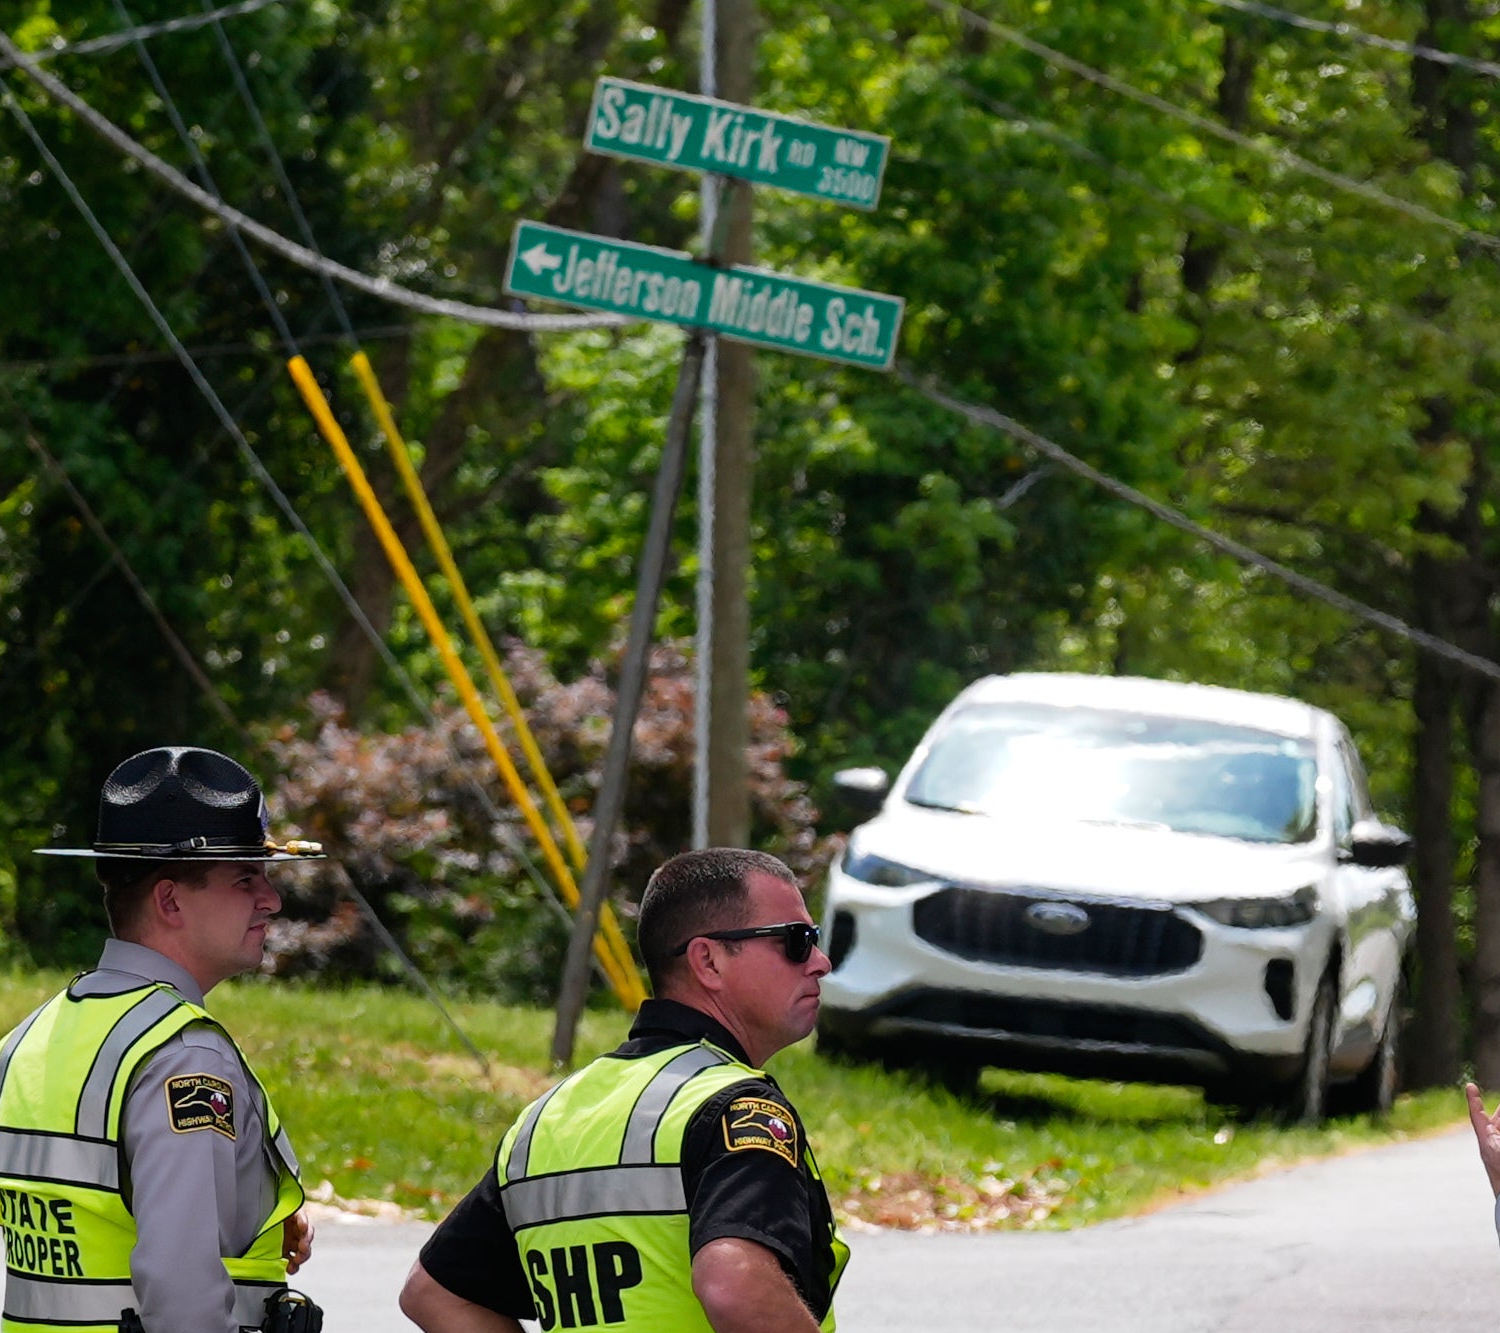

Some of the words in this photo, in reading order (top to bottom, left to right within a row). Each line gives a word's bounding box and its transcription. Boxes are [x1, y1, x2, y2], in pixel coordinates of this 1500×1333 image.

[596, 87, 693, 161] Sally
[701, 106, 782, 174] Kirk
[834, 137, 870, 168] NW
[817, 165, 877, 200] 3500
[552, 244, 702, 319] Jefferson
[708, 272, 813, 343] Middle
[820, 297, 885, 357] Sch.
[172, 1078, 202, 1089] NORTH
[178, 1115, 213, 1127] HIGHWAY
[730, 1102, 760, 1112] NORTH
[3, 1225, 84, 1277] ROOPER
[526, 1241, 643, 1332] SHP
